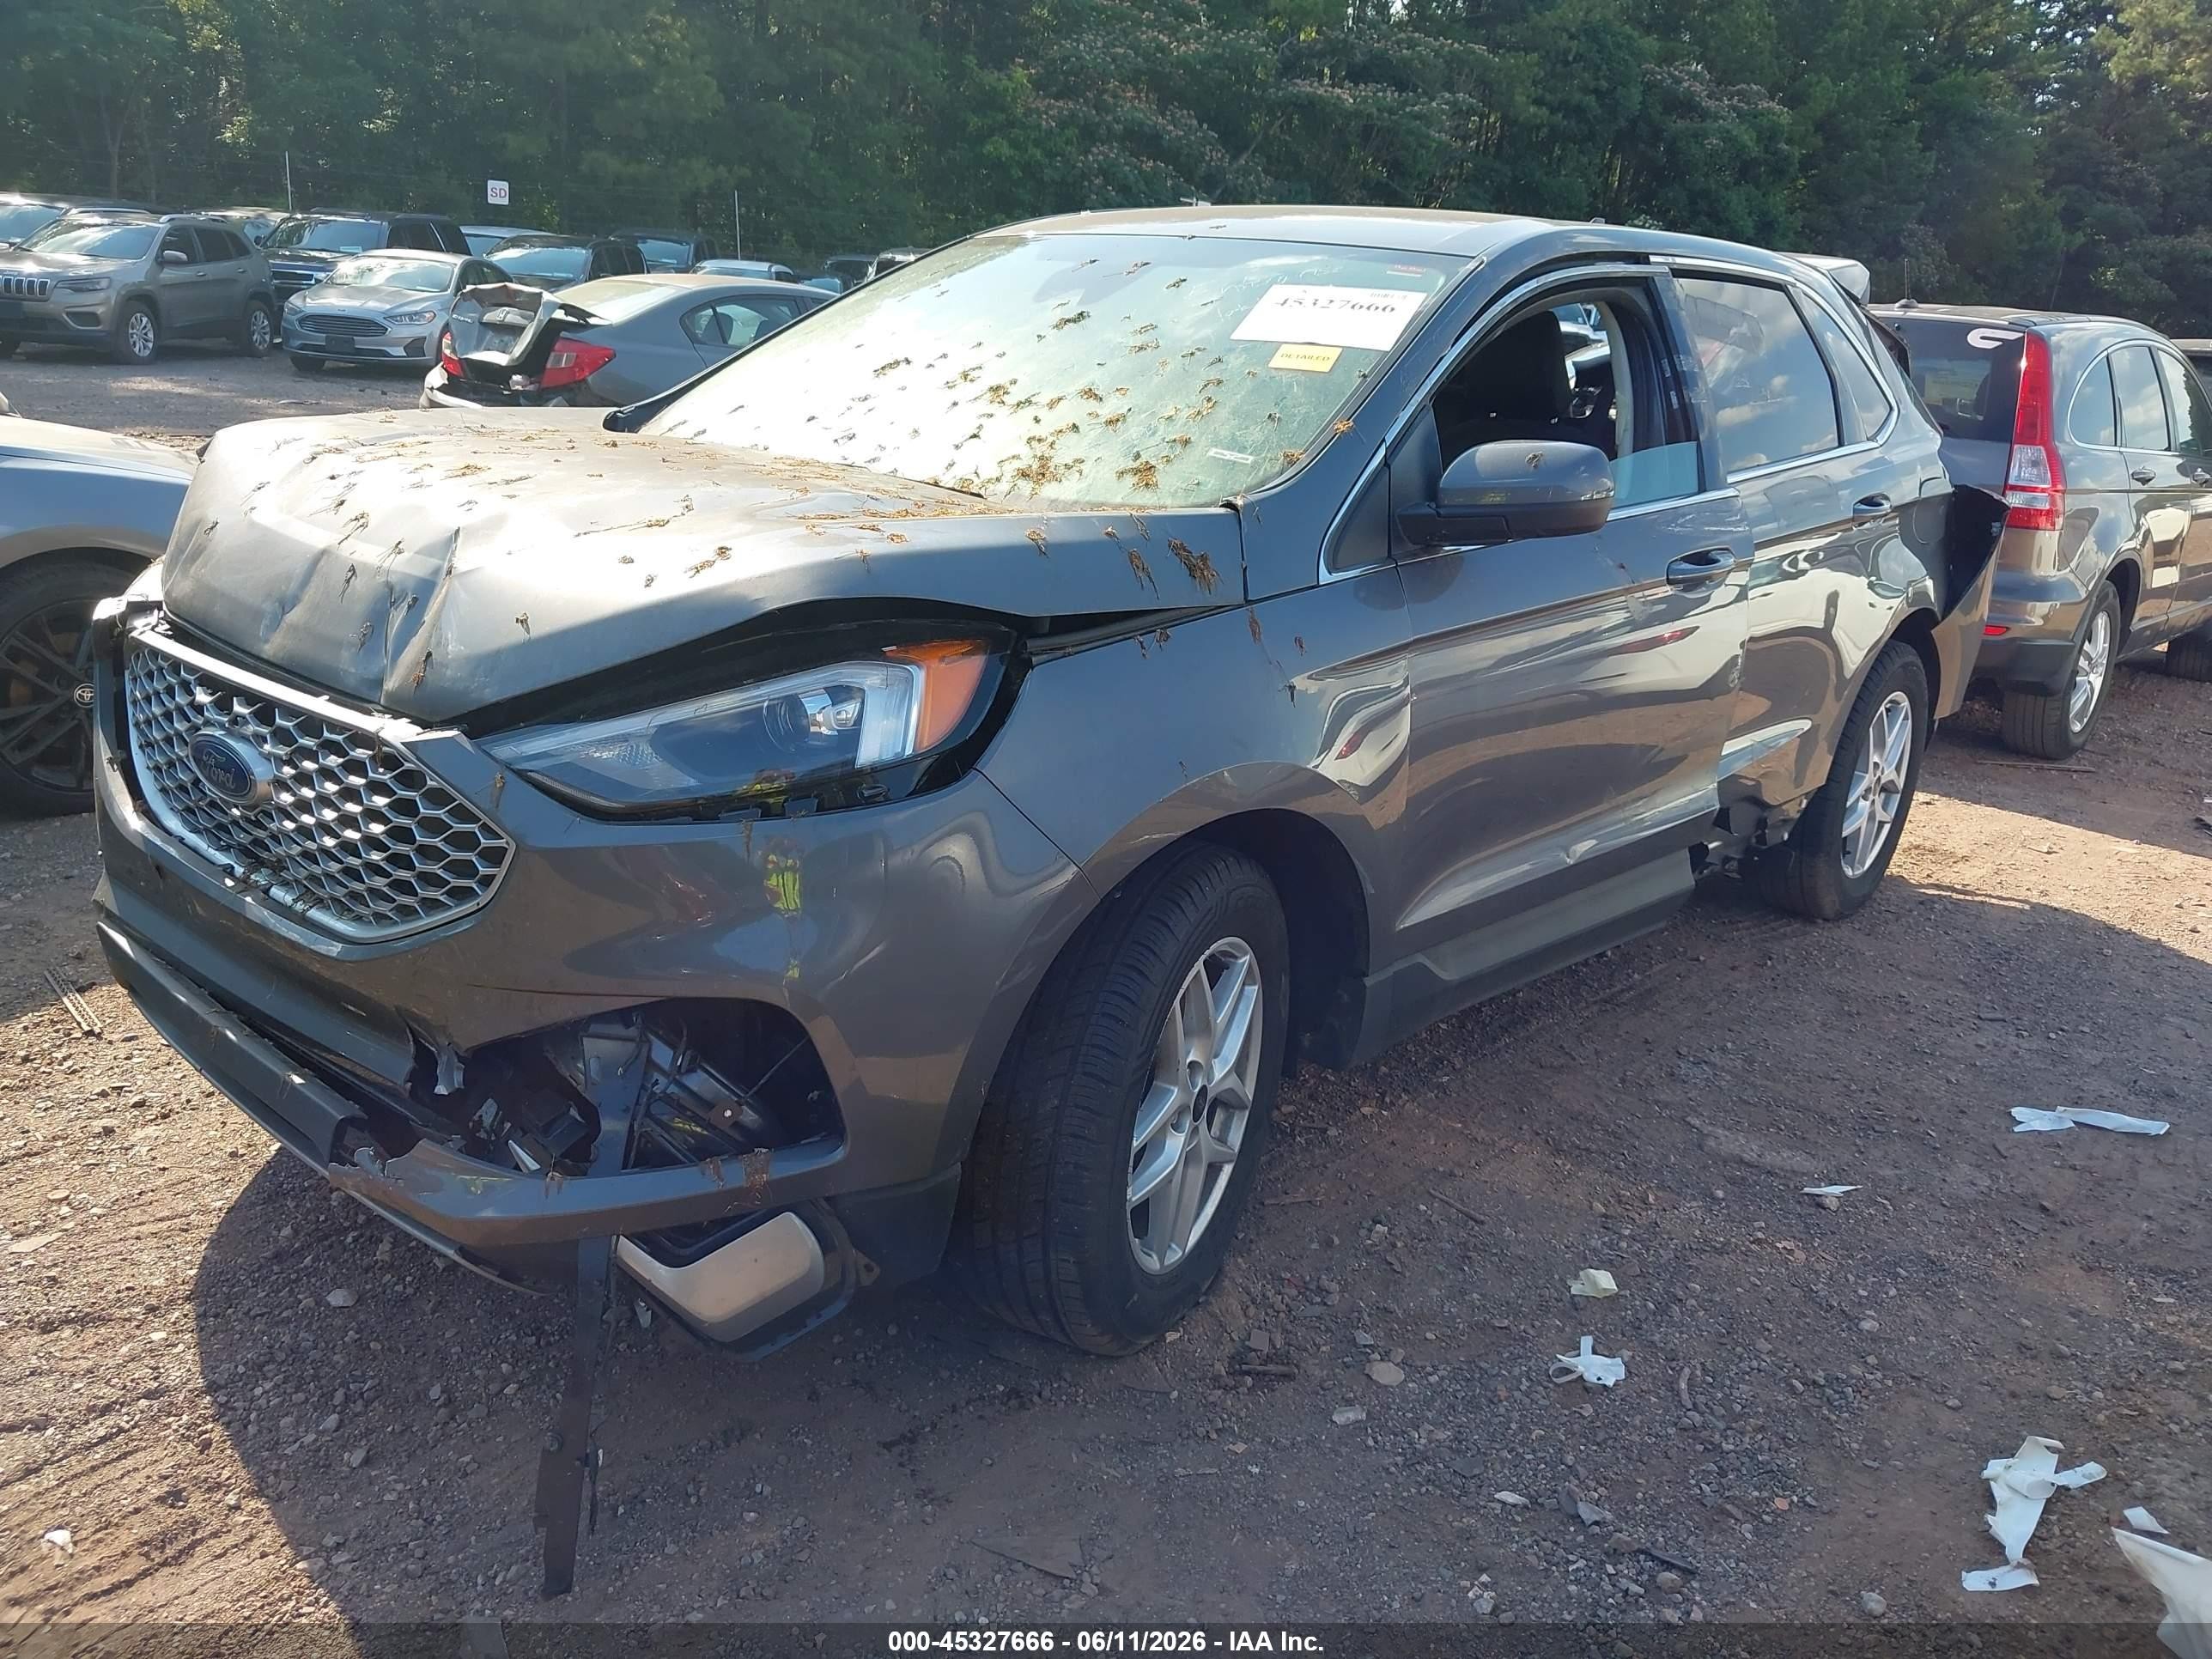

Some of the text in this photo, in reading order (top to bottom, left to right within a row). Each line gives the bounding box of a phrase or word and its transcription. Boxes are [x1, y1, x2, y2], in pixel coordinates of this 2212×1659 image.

[490, 186, 507, 198] SD
[1274, 297, 1396, 313] 45327666
[1280, 353, 1331, 362] DETAILED
[201, 748, 236, 787] Ford
